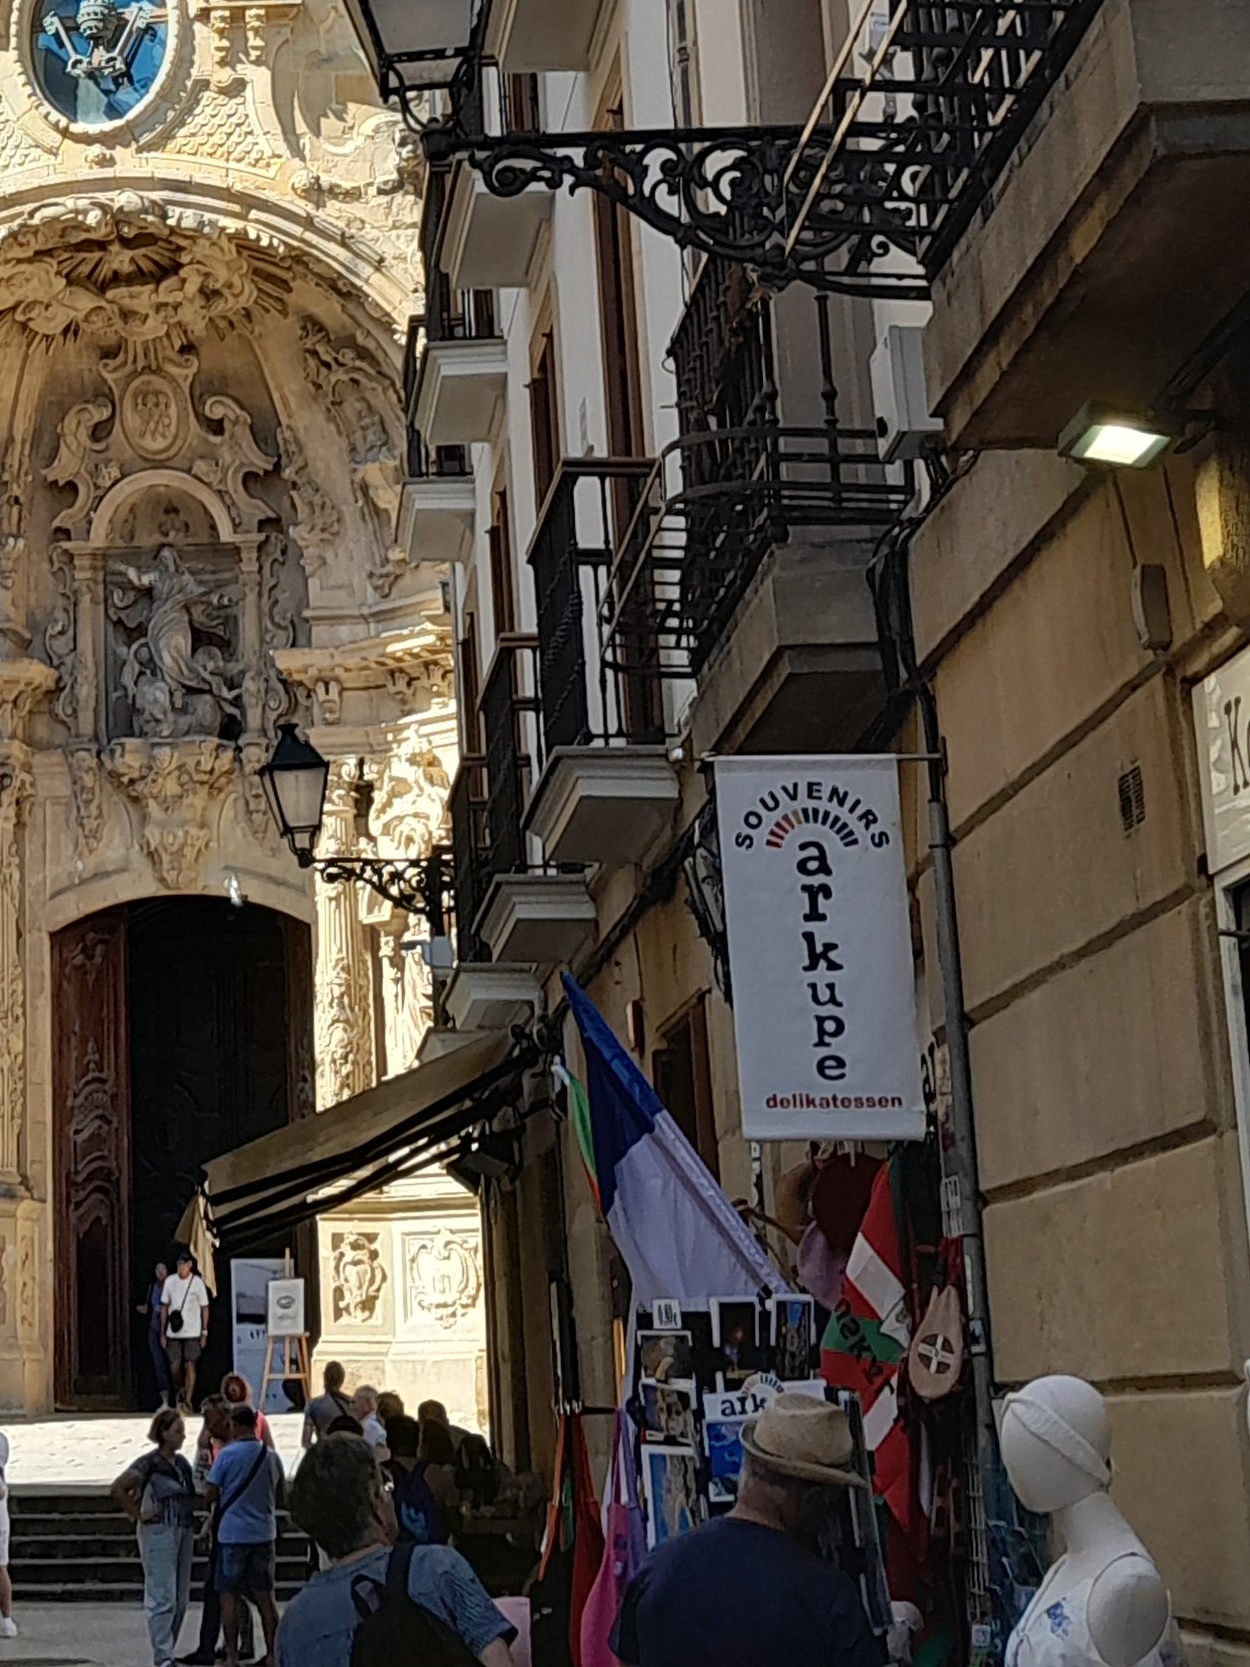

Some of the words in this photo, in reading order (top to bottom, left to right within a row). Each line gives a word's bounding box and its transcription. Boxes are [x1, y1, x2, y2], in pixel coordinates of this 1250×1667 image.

[735, 781, 890, 850] SOUVENIRS
[796, 841, 847, 1081] arkupe
[765, 1092, 903, 1110] delikatessen
